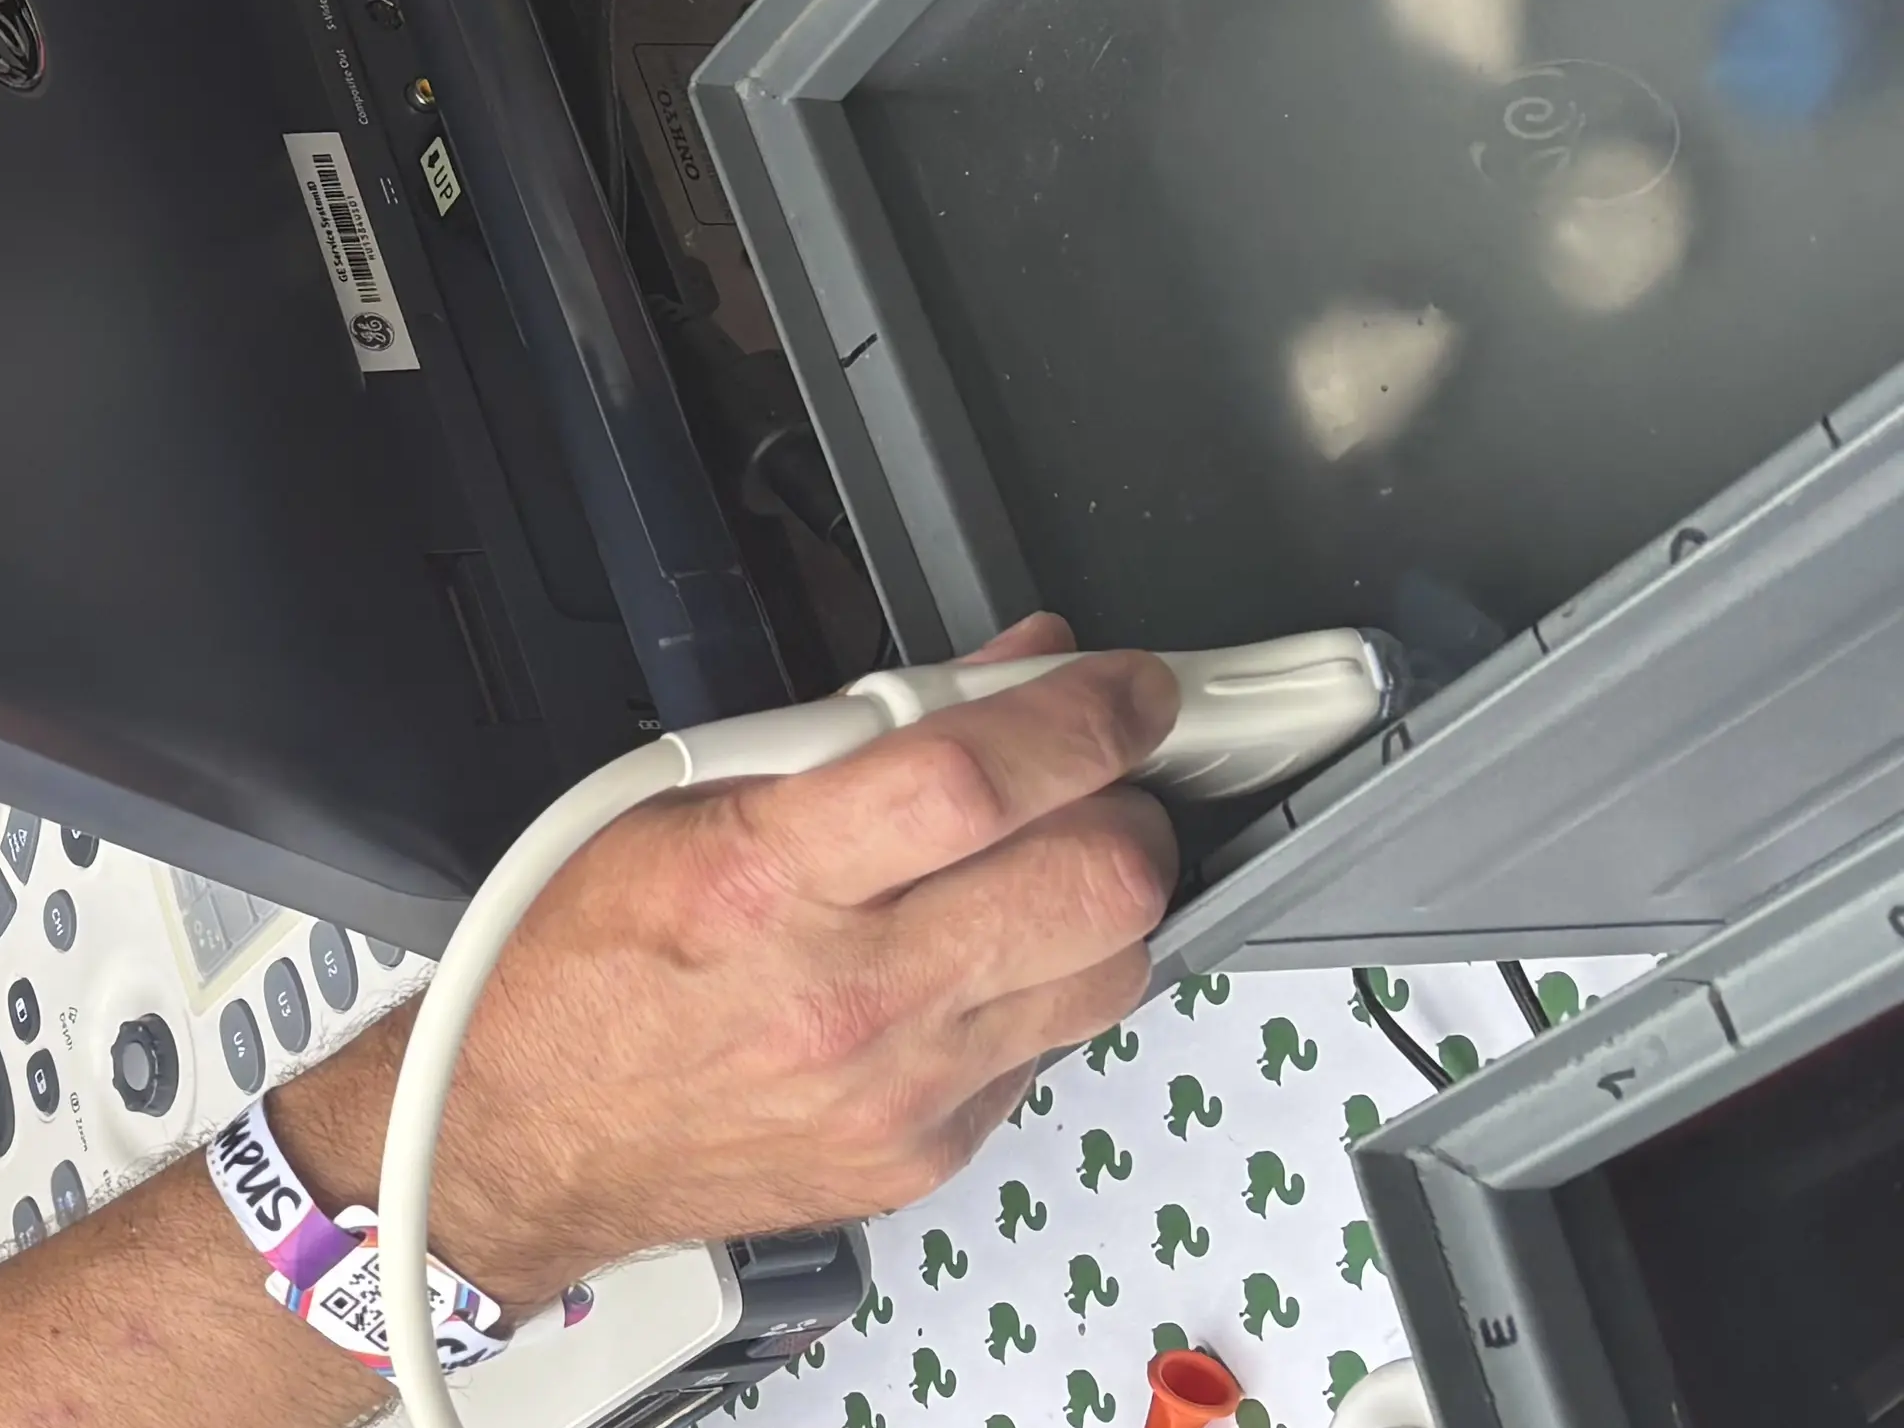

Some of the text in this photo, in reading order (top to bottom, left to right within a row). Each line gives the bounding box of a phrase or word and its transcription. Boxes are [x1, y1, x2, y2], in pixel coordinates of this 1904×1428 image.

[336, 48, 369, 125] Composite Out
[433, 163, 455, 199] UP
[325, 229, 344, 266] Service
[334, 267, 349, 283] GE
[323, 950, 339, 978] U2
[277, 990, 292, 1018] U3
[233, 1031, 247, 1058] U4
[212, 1111, 303, 1233] MPUS
[1480, 1314, 1517, 1349] E
